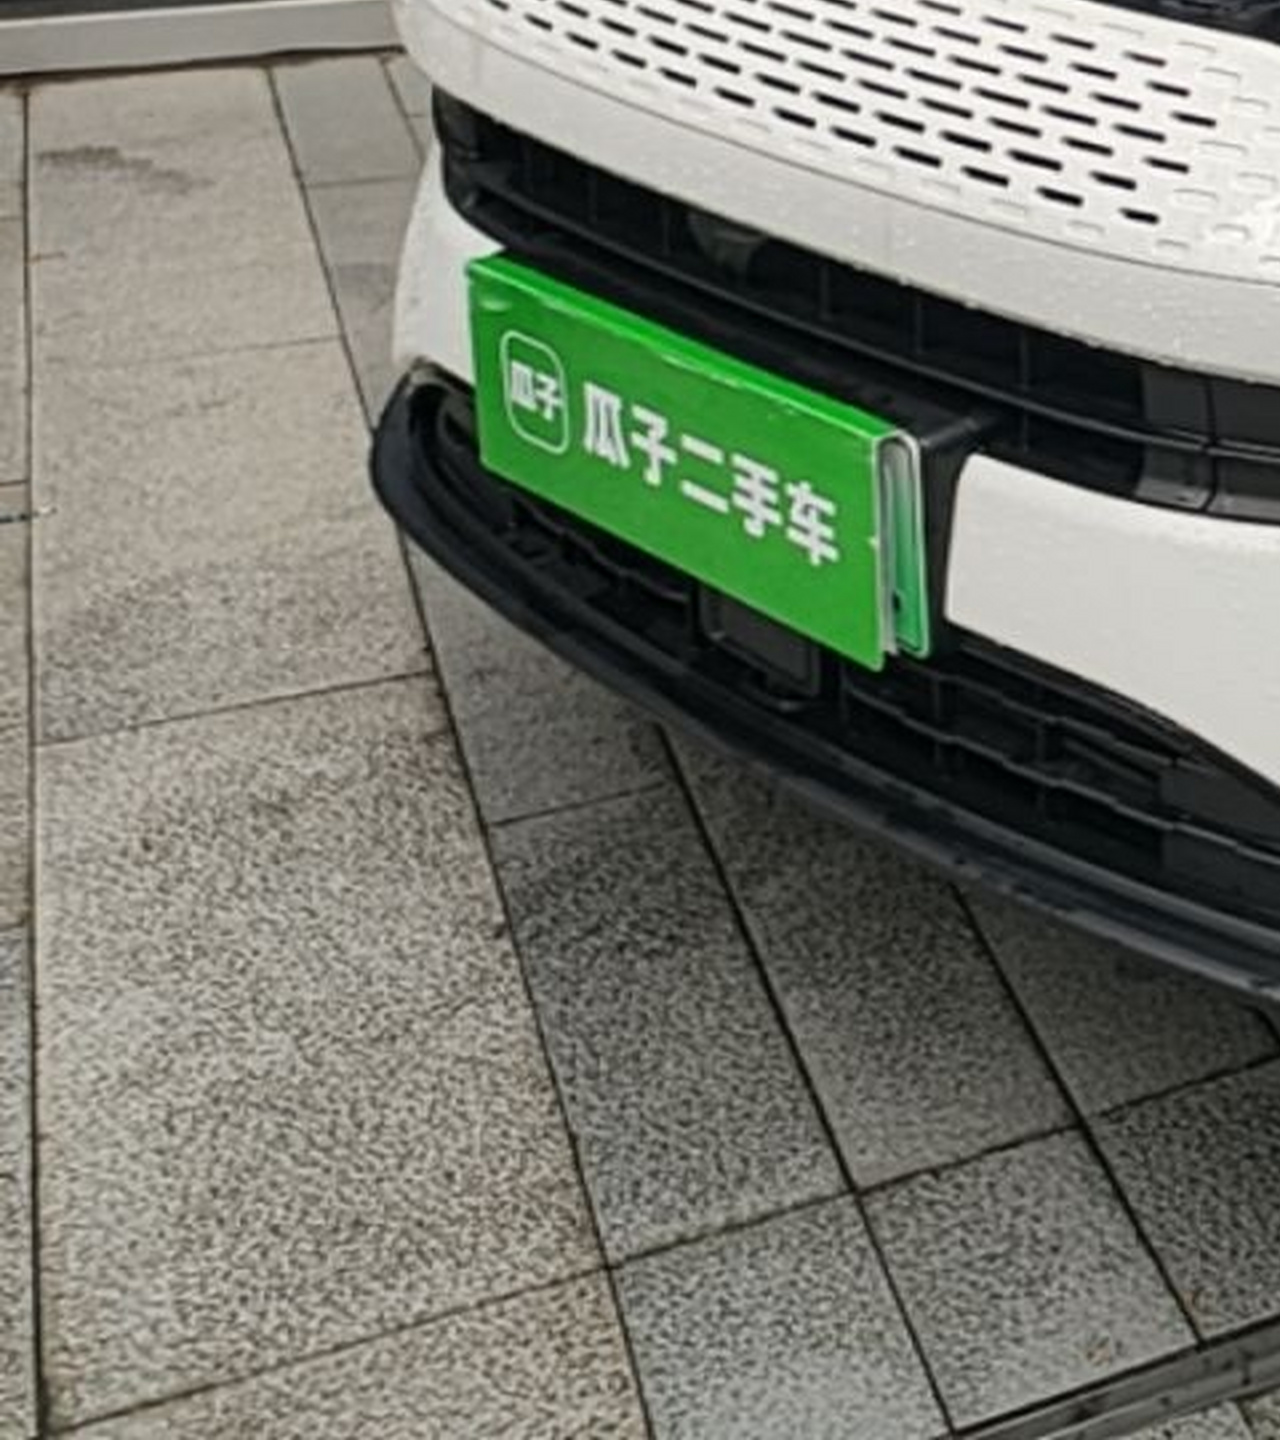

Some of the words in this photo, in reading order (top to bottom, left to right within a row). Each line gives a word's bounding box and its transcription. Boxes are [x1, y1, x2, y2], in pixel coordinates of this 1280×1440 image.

[511, 361, 562, 421] 瓜子
[584, 381, 839, 565] 瓜子二手车
